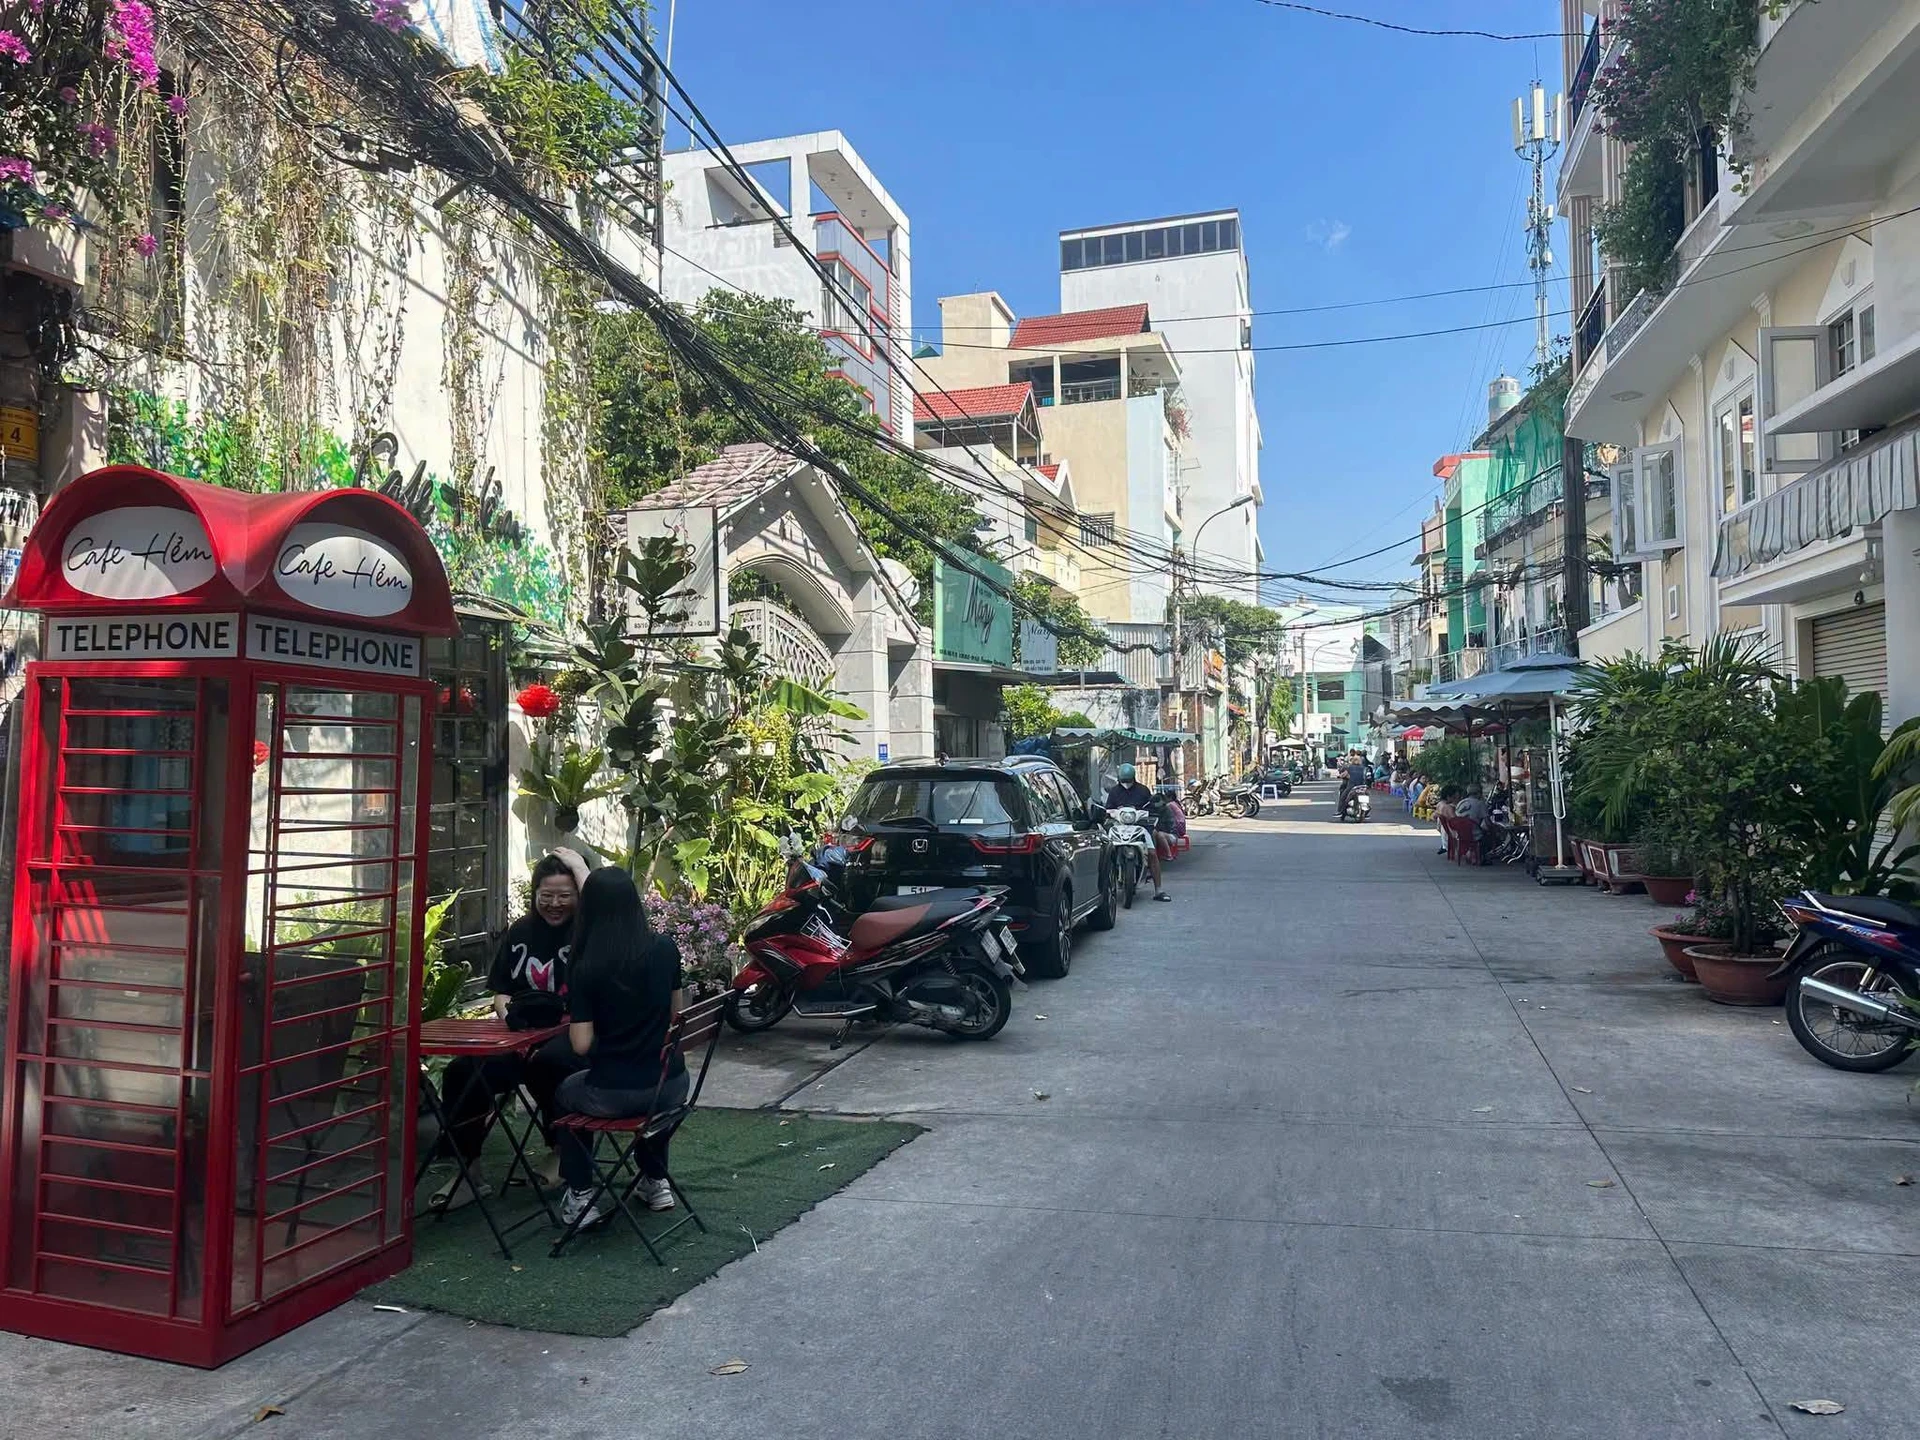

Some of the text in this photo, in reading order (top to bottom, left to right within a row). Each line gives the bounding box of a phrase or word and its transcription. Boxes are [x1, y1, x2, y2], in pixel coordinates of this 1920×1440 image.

[10, 427, 21, 443] 4
[67, 532, 213, 573] Cafe Hẻm
[278, 544, 407, 590] Cafe Hẻm
[57, 621, 230, 652] TELEPHONE
[255, 623, 413, 669] TELEPHONE
